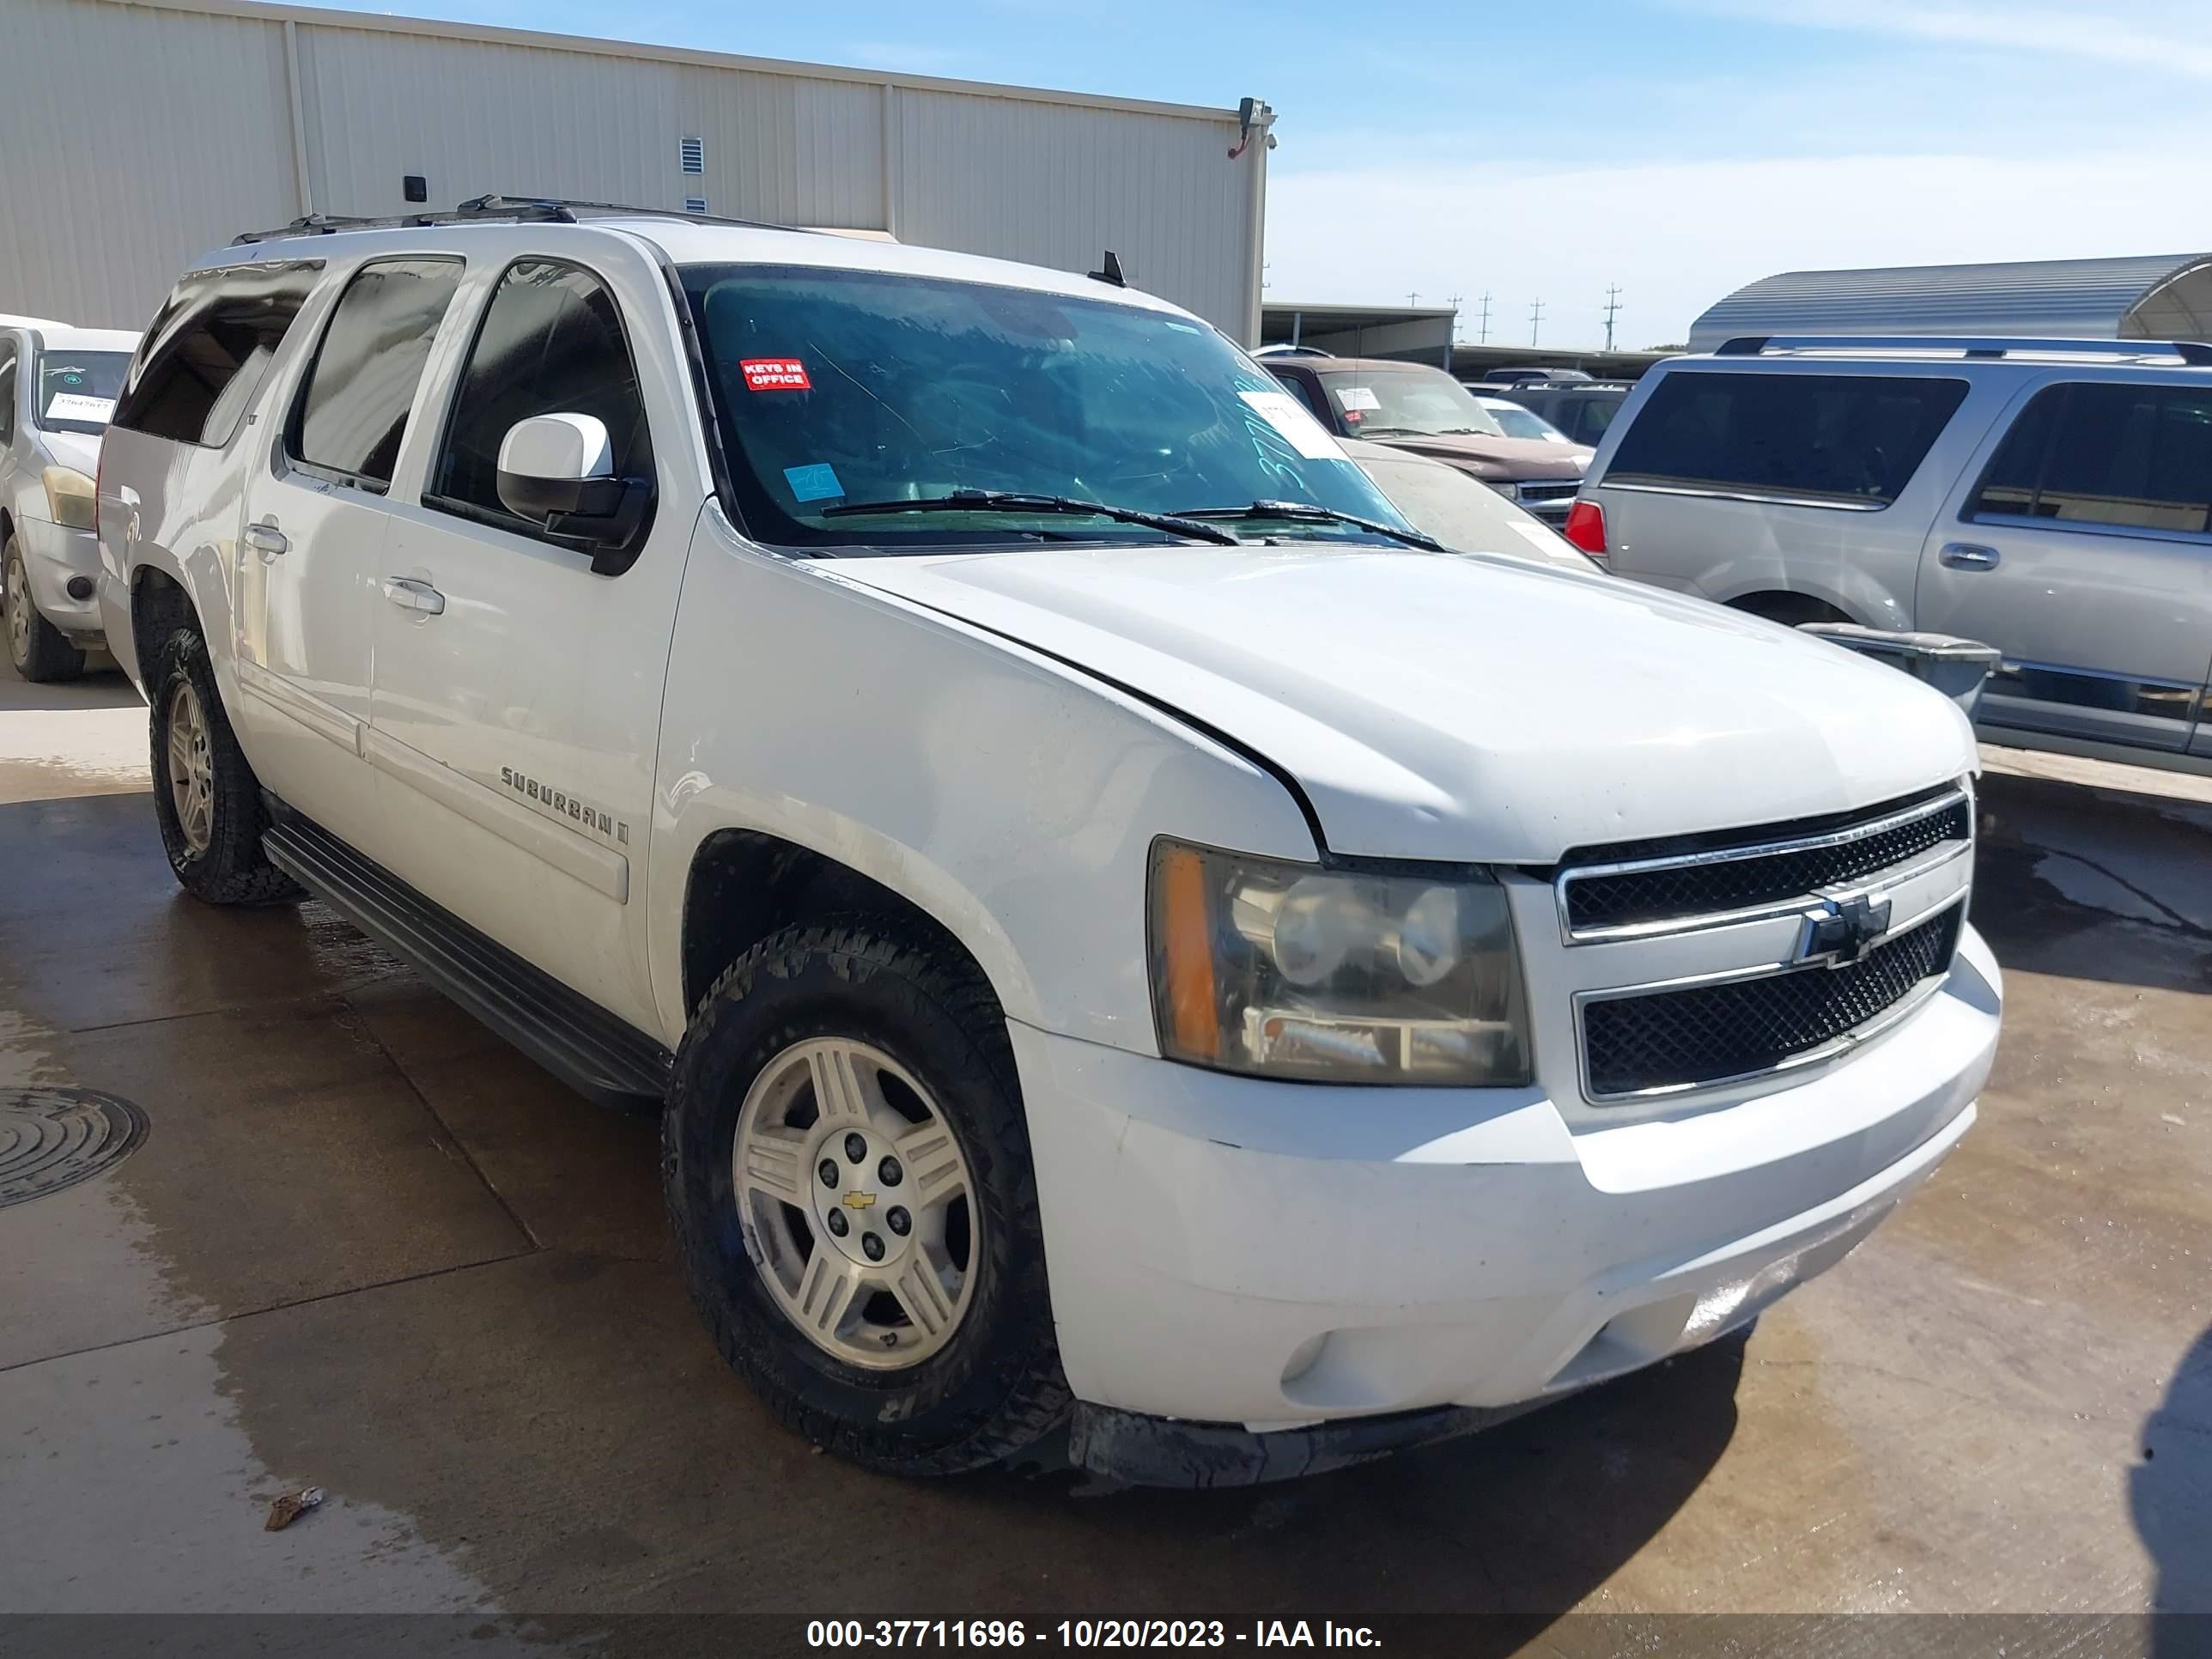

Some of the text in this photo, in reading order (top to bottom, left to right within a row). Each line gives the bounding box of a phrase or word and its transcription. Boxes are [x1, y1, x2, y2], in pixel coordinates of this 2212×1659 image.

[744, 364, 803, 374] KEYS IN
[752, 375, 804, 385] OFFICE
[501, 766, 612, 836] SUBURBAN
